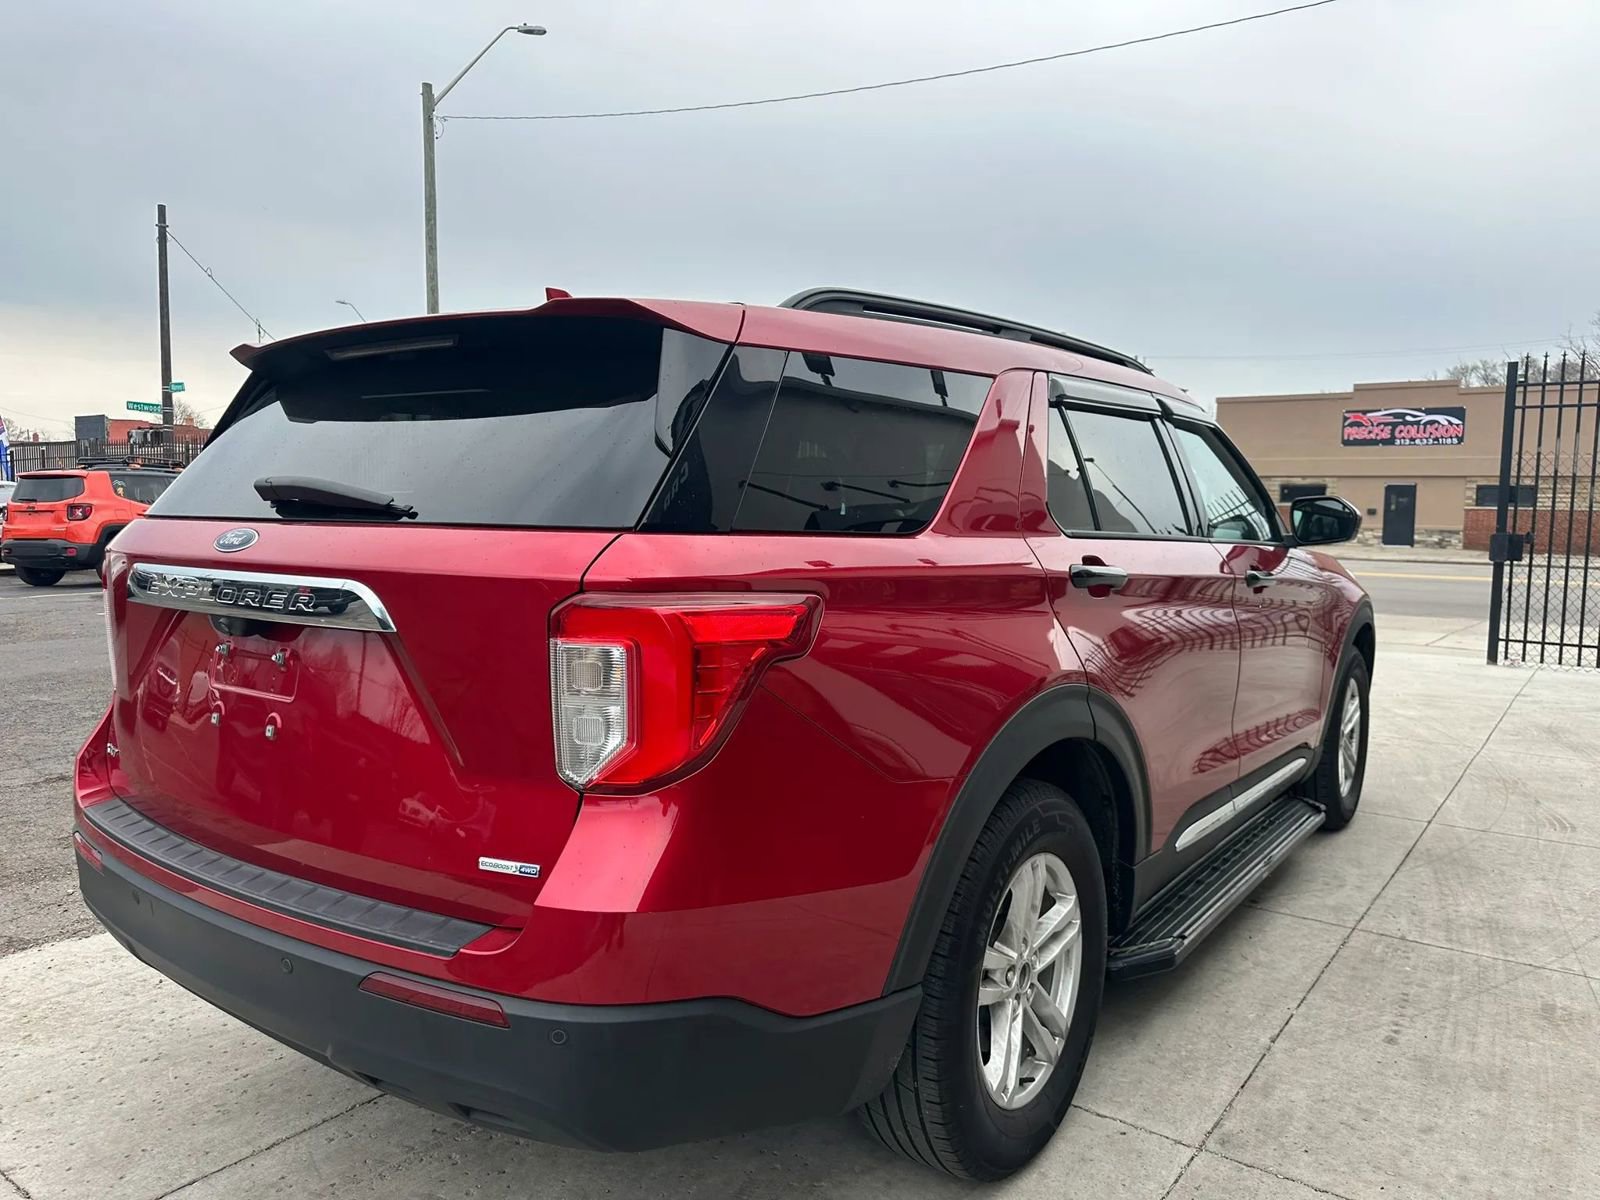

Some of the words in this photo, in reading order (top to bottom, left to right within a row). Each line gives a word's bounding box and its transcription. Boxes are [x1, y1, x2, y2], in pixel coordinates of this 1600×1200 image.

[127, 402, 161, 412] Westwood
[1343, 425, 1392, 440] PRECISE
[1394, 424, 1463, 438] COLLISION
[147, 573, 316, 612] EXPLORER
[520, 866, 537, 875] 4WD
